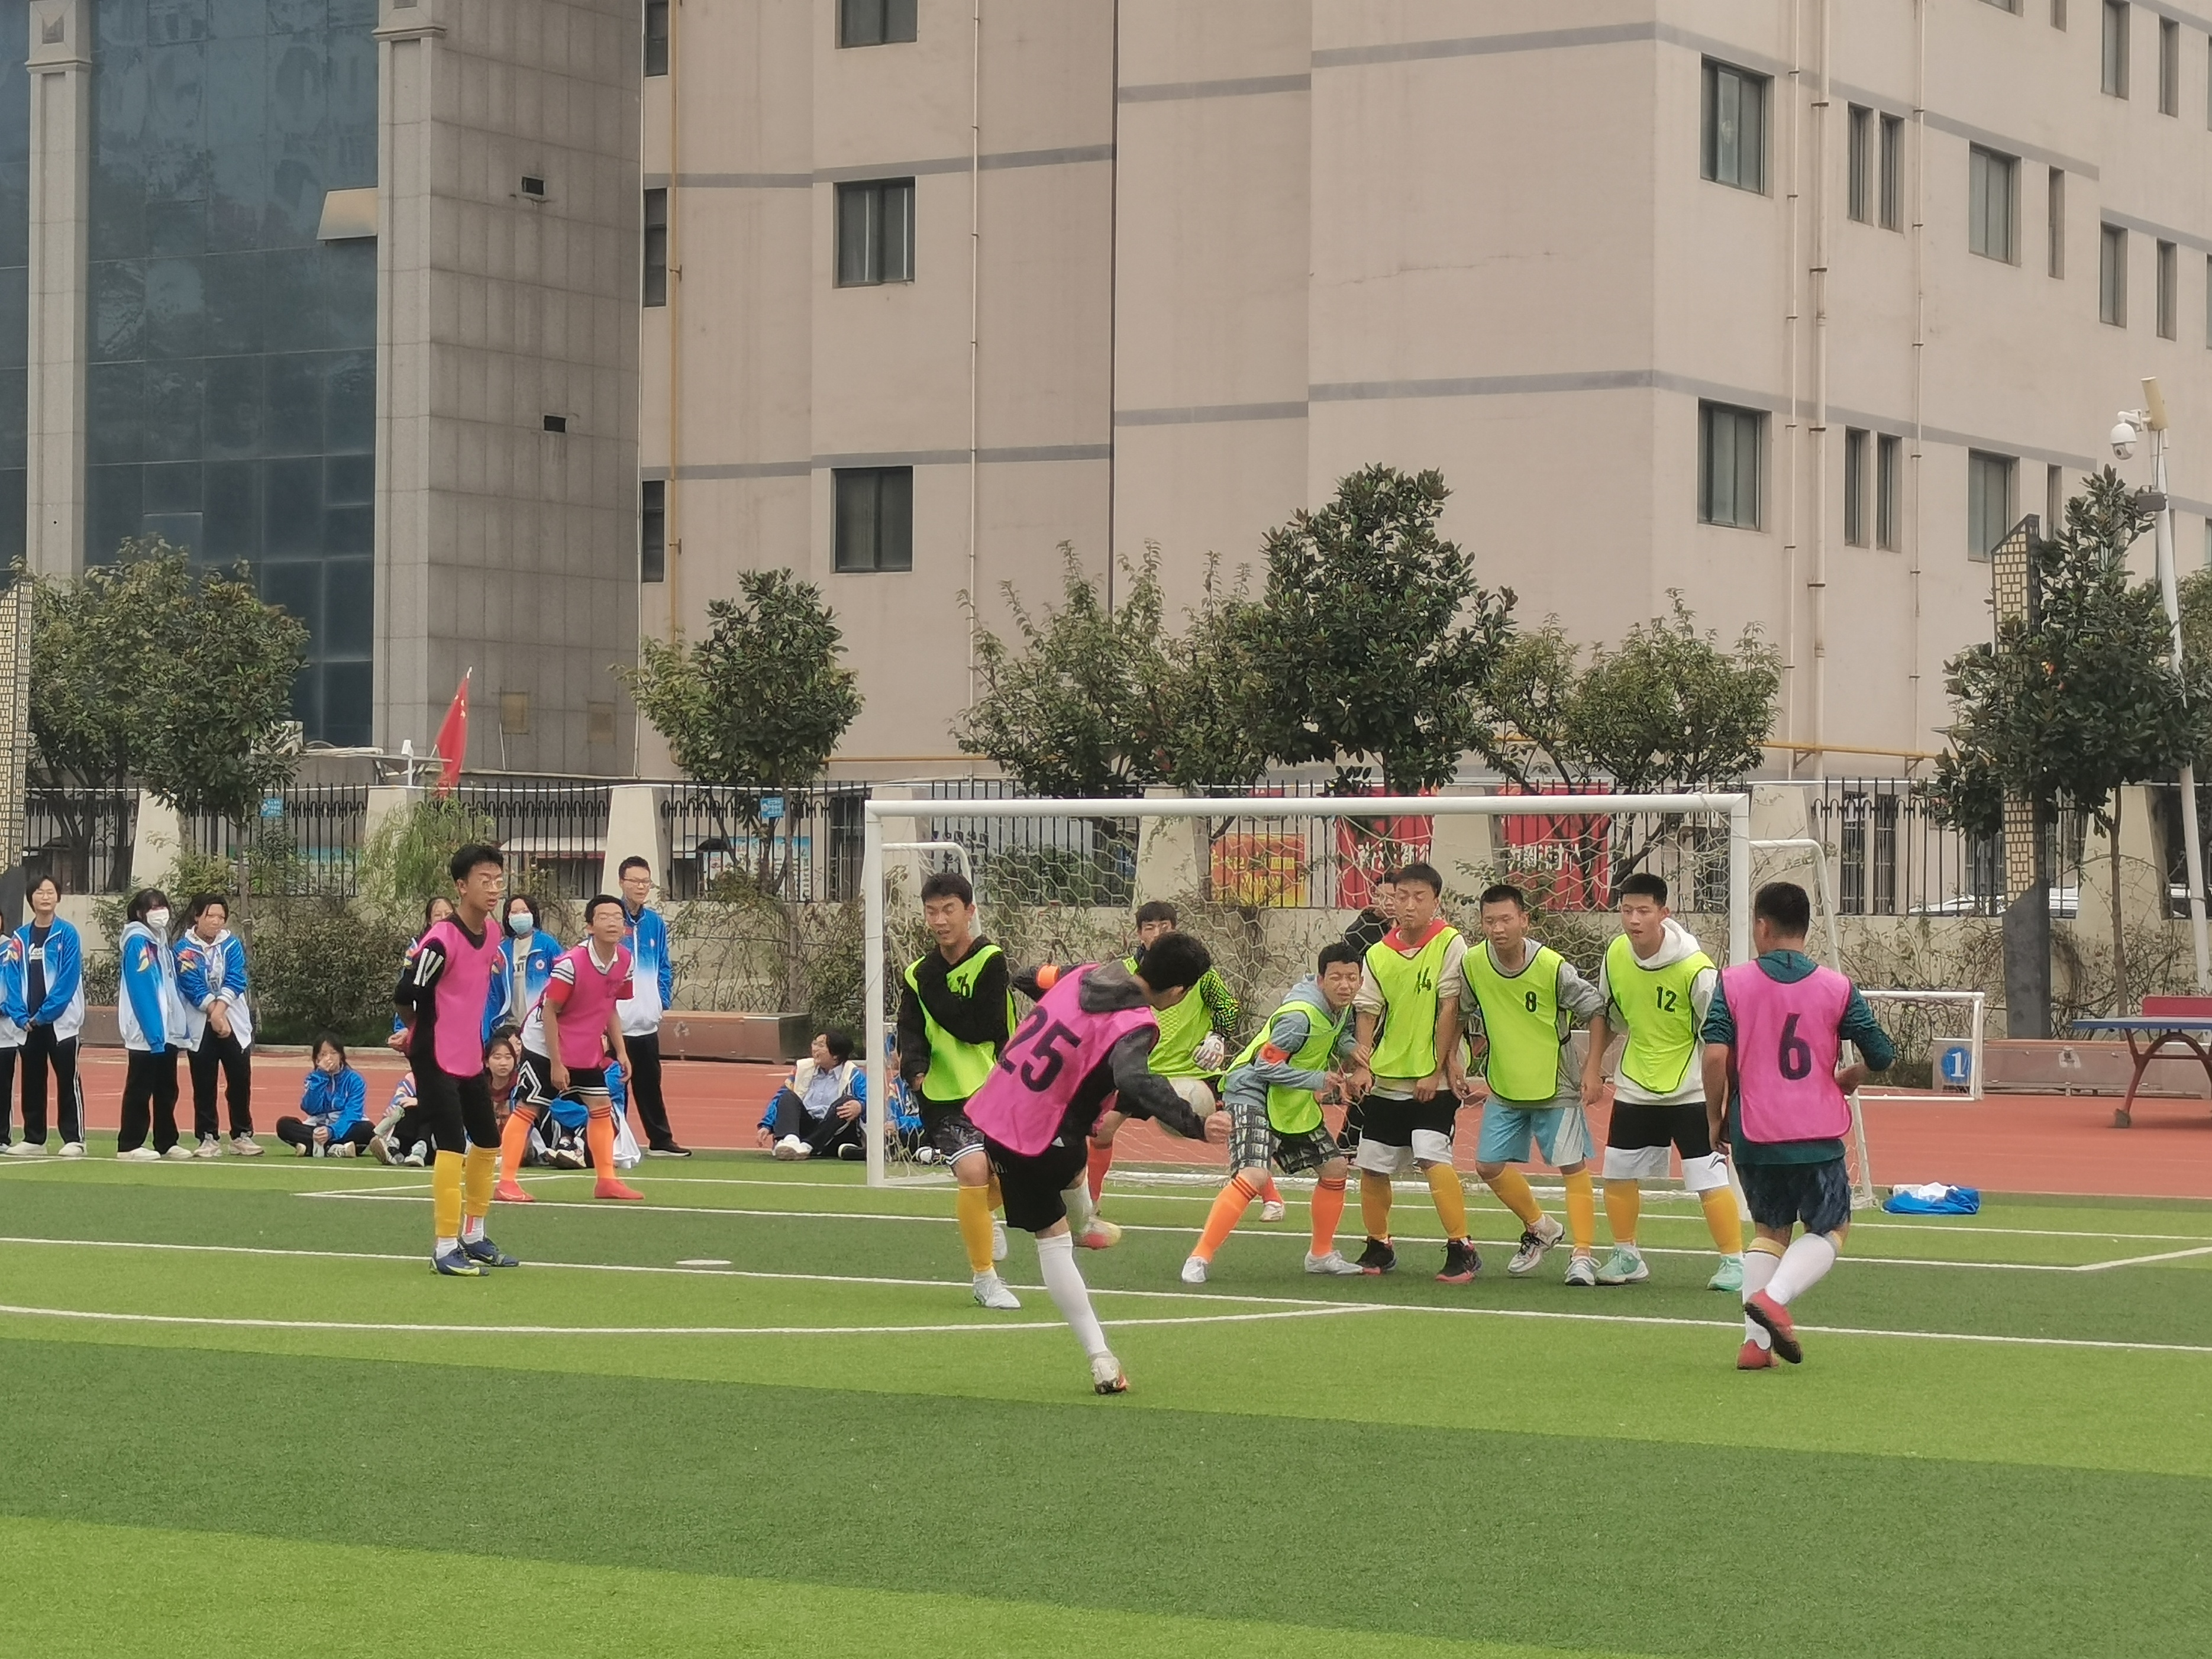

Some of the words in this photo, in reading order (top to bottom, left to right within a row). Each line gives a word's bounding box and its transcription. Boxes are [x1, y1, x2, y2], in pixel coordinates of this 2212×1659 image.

[1417, 966, 1432, 995] 14
[1525, 991, 1537, 1012] 8
[1656, 986, 1677, 1012] 12
[998, 1005, 1082, 1092] 25
[1778, 1012, 1811, 1080] 6
[1951, 1052, 1965, 1077] 1
